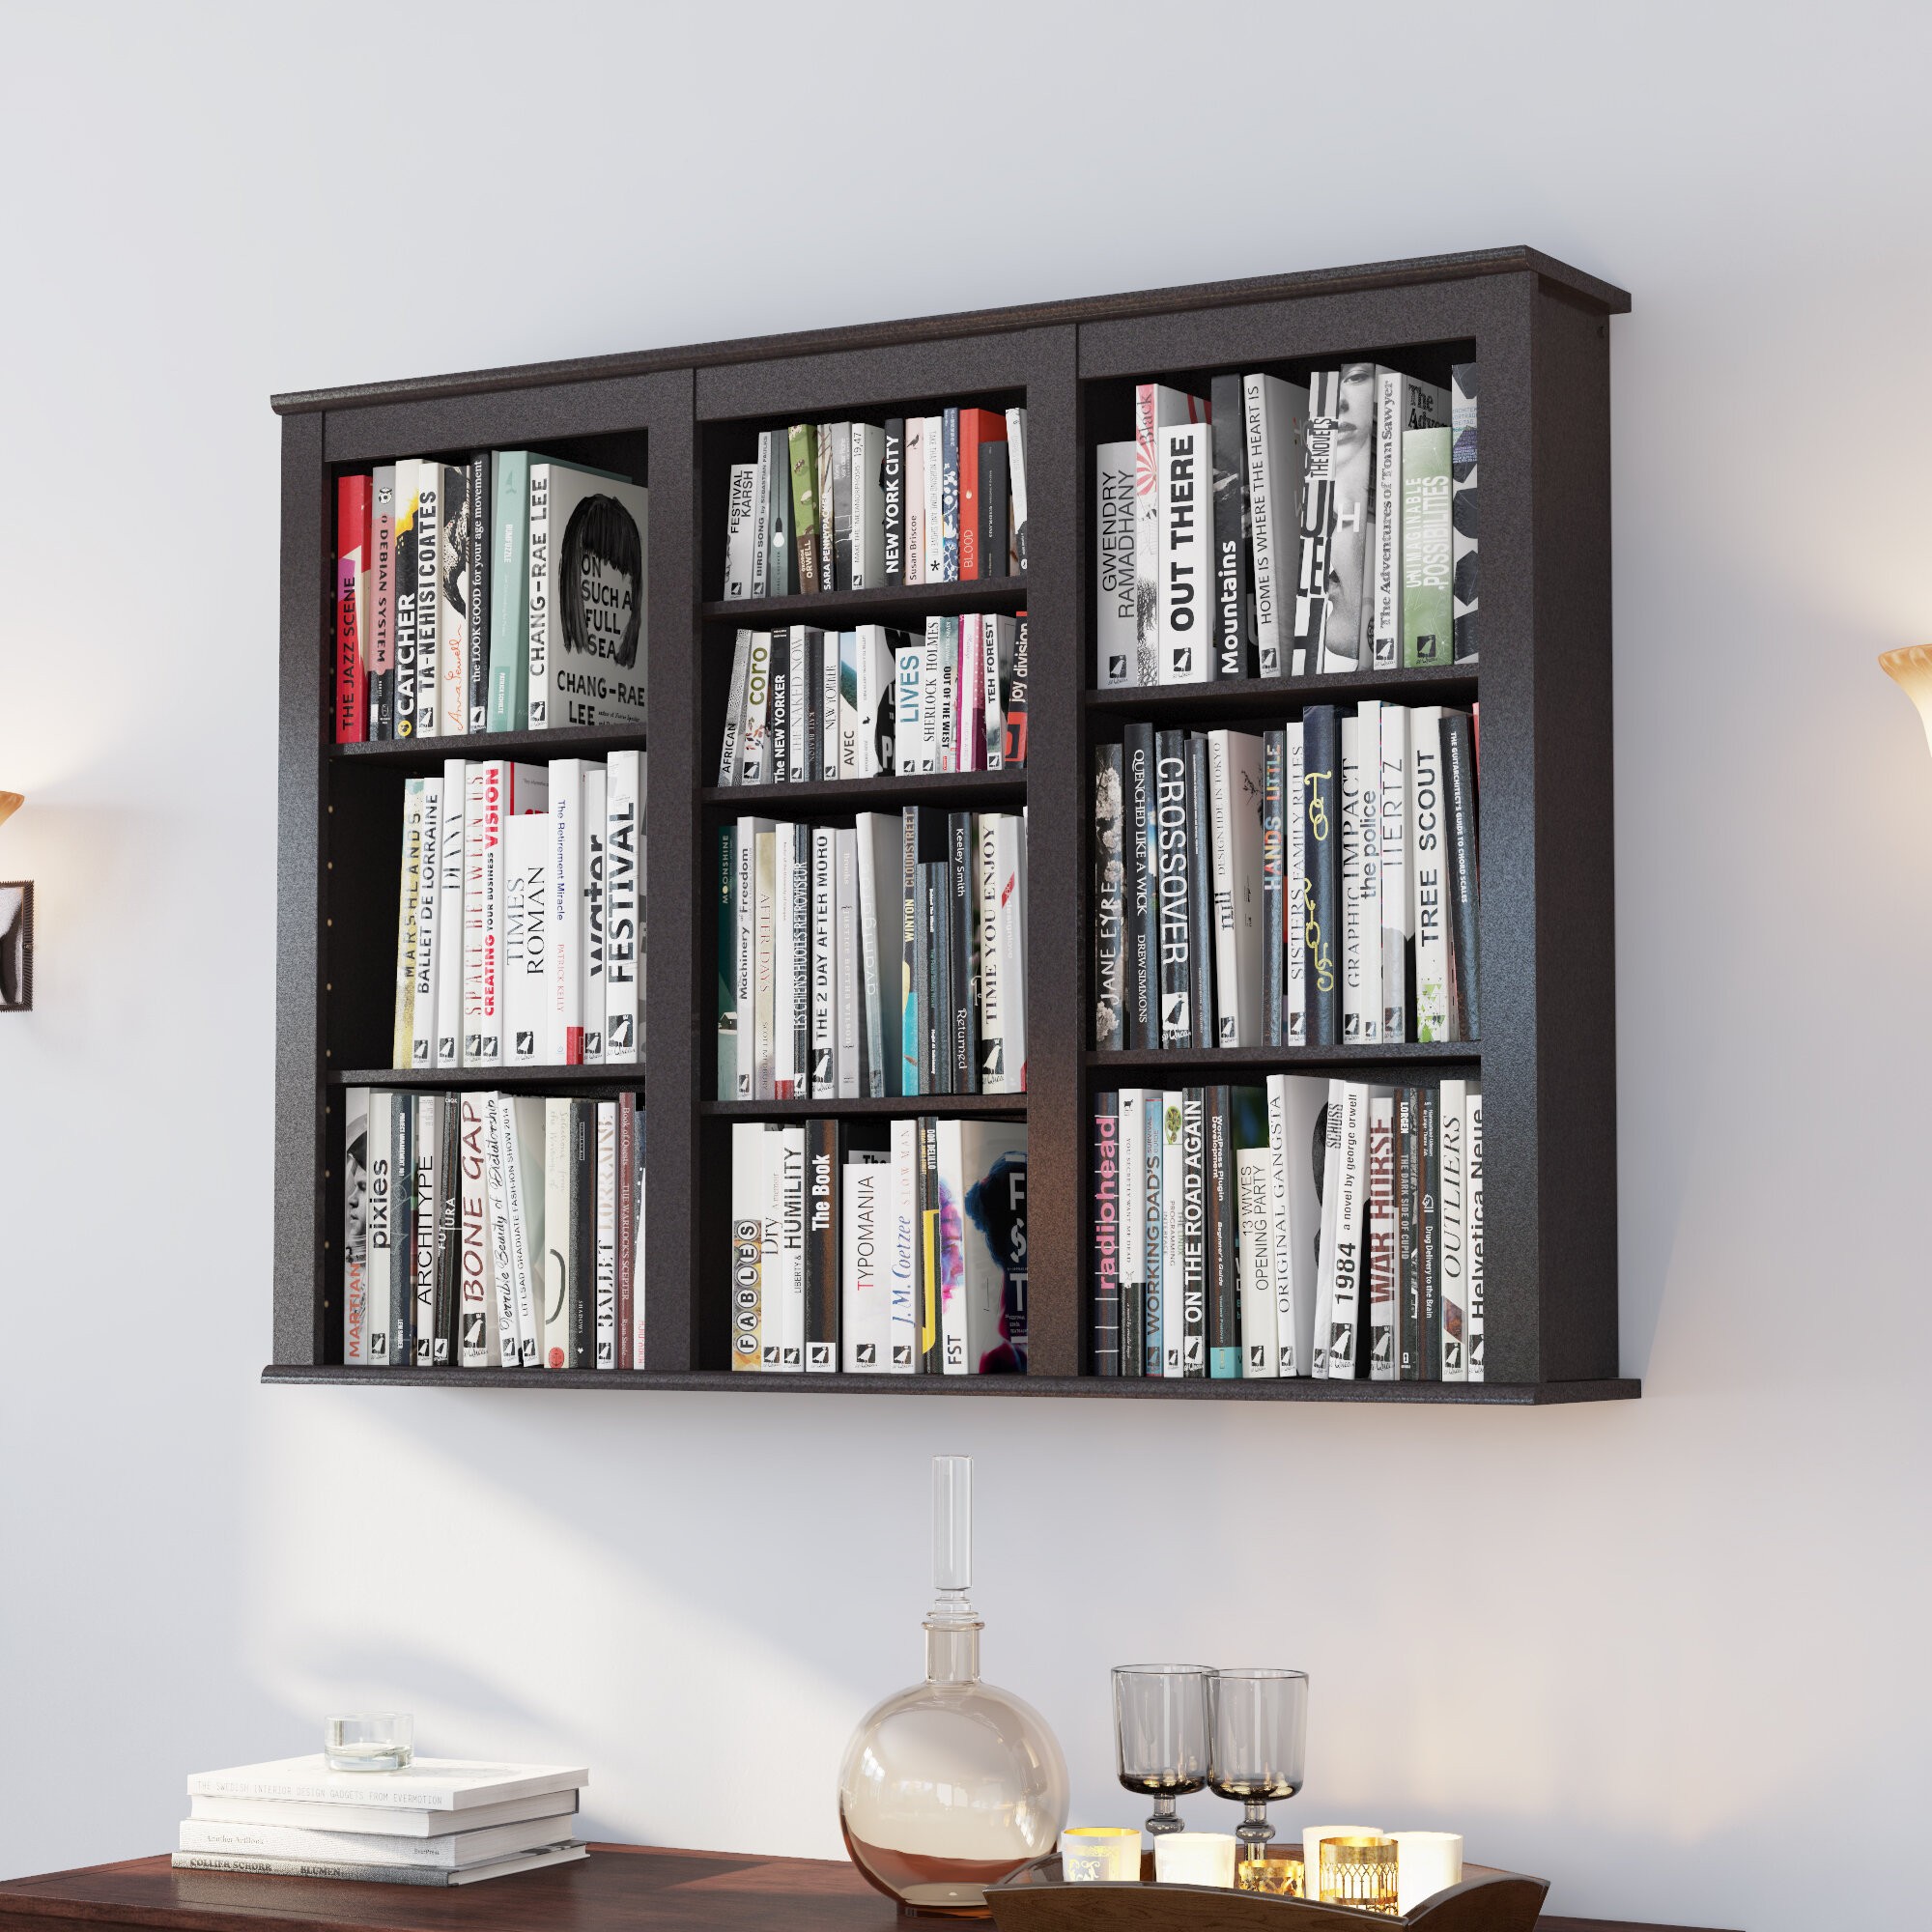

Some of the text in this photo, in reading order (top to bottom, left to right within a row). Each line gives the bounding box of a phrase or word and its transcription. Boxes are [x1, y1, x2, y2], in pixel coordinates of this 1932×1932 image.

[475, 521, 484, 539] age
[731, 470, 742, 533] FESTIVAL
[741, 470, 753, 517] KARSH
[886, 436, 898, 573] NEW YORK CITY
[1102, 471, 1117, 592] GWENDRY
[1171, 435, 1194, 632] OUT THERE
[1247, 386, 1271, 624] HOME IS WHERE THE HEART IS
[1380, 382, 1395, 629] The Adventures of Tom Sawyer
[472, 574, 481, 585] for
[474, 543, 483, 571] your
[530, 478, 547, 676] CHANG-RAE LEE
[582, 554, 601, 578] ON
[964, 530, 973, 567] BLOOD
[1118, 469, 1134, 618] RAMADHANY
[377, 529, 388, 662] DEBIAN SYSTEM
[472, 588, 481, 624] GOOD
[581, 580, 632, 611] SUCH A
[586, 610, 621, 635] FULL
[1219, 540, 1238, 673] Mountains
[343, 578, 355, 730] THE JAZZ SCENE
[398, 593, 415, 715] CATCHER
[472, 628, 481, 668] LOOK
[472, 671, 481, 682] the
[588, 634, 615, 659] SEA
[923, 622, 938, 741] SHERLOCK HOLMES
[557, 669, 645, 706] CHANG-RAE
[569, 700, 595, 725] LEE
[900, 656, 919, 723] LIVES
[944, 690, 951, 698] OF
[723, 724, 735, 773] AFRICAN
[775, 675, 784, 783] The NEW YORKER
[844, 730, 854, 766] AVEC
[485, 769, 498, 847] VISION
[1264, 745, 1282, 891] HANDS LITTLE
[1453, 748, 1463, 811] GUITARCHITECT'S
[557, 823, 566, 879] Retirement
[905, 810, 915, 942] WINTON CLOUDSTREET
[956, 828, 965, 896] Keeley Smith
[1159, 757, 1188, 963] CROSSOVER
[1343, 757, 1360, 988] GRAPHIC IMPACT
[1360, 790, 1379, 898] the police
[1417, 750, 1438, 947] TREE SCOUT
[417, 794, 438, 993] BALLET DE LORRAINE
[507, 877, 525, 965] TIMES
[526, 867, 545, 974] ROMAN
[609, 803, 634, 983] FESTIVAL
[983, 825, 997, 1024] TIME YOU ENJOY
[485, 935, 495, 1016] CREATING
[1138, 934, 1148, 1022] DREW SIMMONS
[957, 1009, 967, 1068] Returned
[1346, 1132, 1356, 1170] george
[1348, 1094, 1357, 1128] orwell
[369, 1159, 390, 1248] pixies
[462, 1100, 484, 1302] BONE GAP
[812, 1154, 830, 1231] The Book
[1096, 1118, 1116, 1290] radiohead
[1184, 1100, 1202, 1322] ON THE ROAD AGAIN
[1241, 1167, 1253, 1236] 13 WIVES
[1269, 1095, 1291, 1313] ORIGINAL GANGSTA
[1343, 1190, 1352, 1220] novel
[1344, 1174, 1355, 1186] by
[1371, 1117, 1394, 1303] WAR HORSE
[1444, 1115, 1462, 1278] OUTLIERS
[417, 1155, 433, 1306] ARCHITYPE
[858, 1176, 873, 1291] TYPOMANIA
[1253, 1166, 1269, 1290] OPENING PARTY
[1402, 1221, 1409, 1231] OF
[1425, 1226, 1434, 1242] Drug
[1425, 1245, 1434, 1275] Delivery
[349, 1263, 361, 1358] MARTIAN
[1335, 1242, 1356, 1305] 1984
[948, 1335, 961, 1365] FST
[393, 1794, 442, 1804] EVERMOTION
